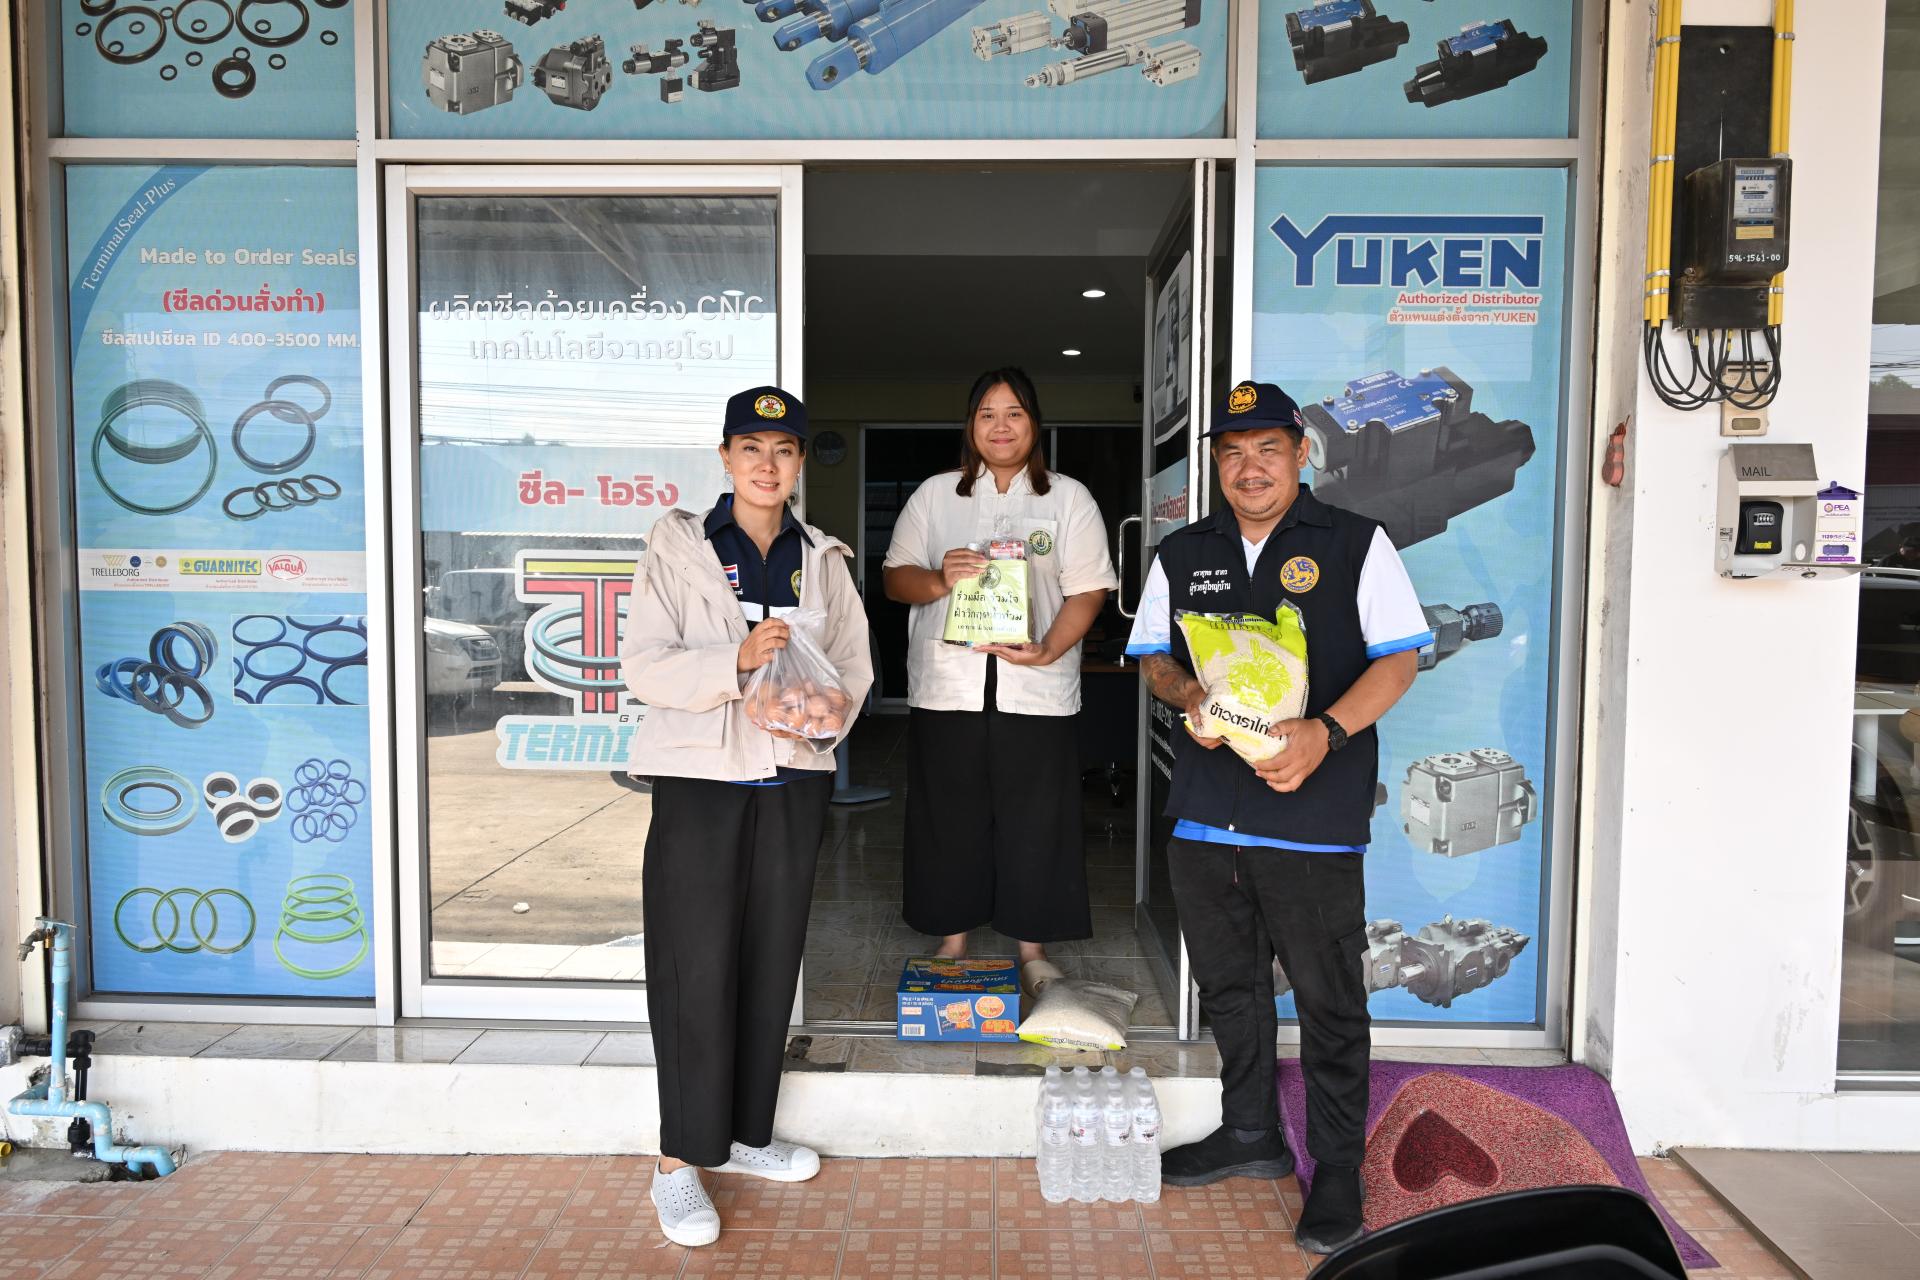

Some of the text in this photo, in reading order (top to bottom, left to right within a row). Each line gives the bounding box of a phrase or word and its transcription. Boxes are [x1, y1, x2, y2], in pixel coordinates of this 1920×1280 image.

[81, 176, 176, 292] TerminalSeal-Plus
[140, 248, 356, 266] Made to Order Seals
[1268, 213, 1544, 287] YUKEN
[163, 283, 325, 314] (ซีลด่วนสั่งทำ)
[429, 285, 764, 322] ผลิตซีลด้วยเครื่อง CNC
[1398, 293, 1540, 305] Authorized Distributor
[1494, 312, 1536, 323] YUKEN
[203, 333, 220, 347] ID
[227, 332, 320, 348] 400-3500
[469, 330, 734, 371] เทคโนโลยีจากยุโรป
[1741, 466, 1773, 477] MAIL
[597, 475, 679, 507] โอริง
[91, 568, 140, 577] TRELLEBORG
[194, 560, 258, 573] GUARNITEC
[268, 559, 304, 575] VALQUA
[505, 724, 638, 763] TERMI
